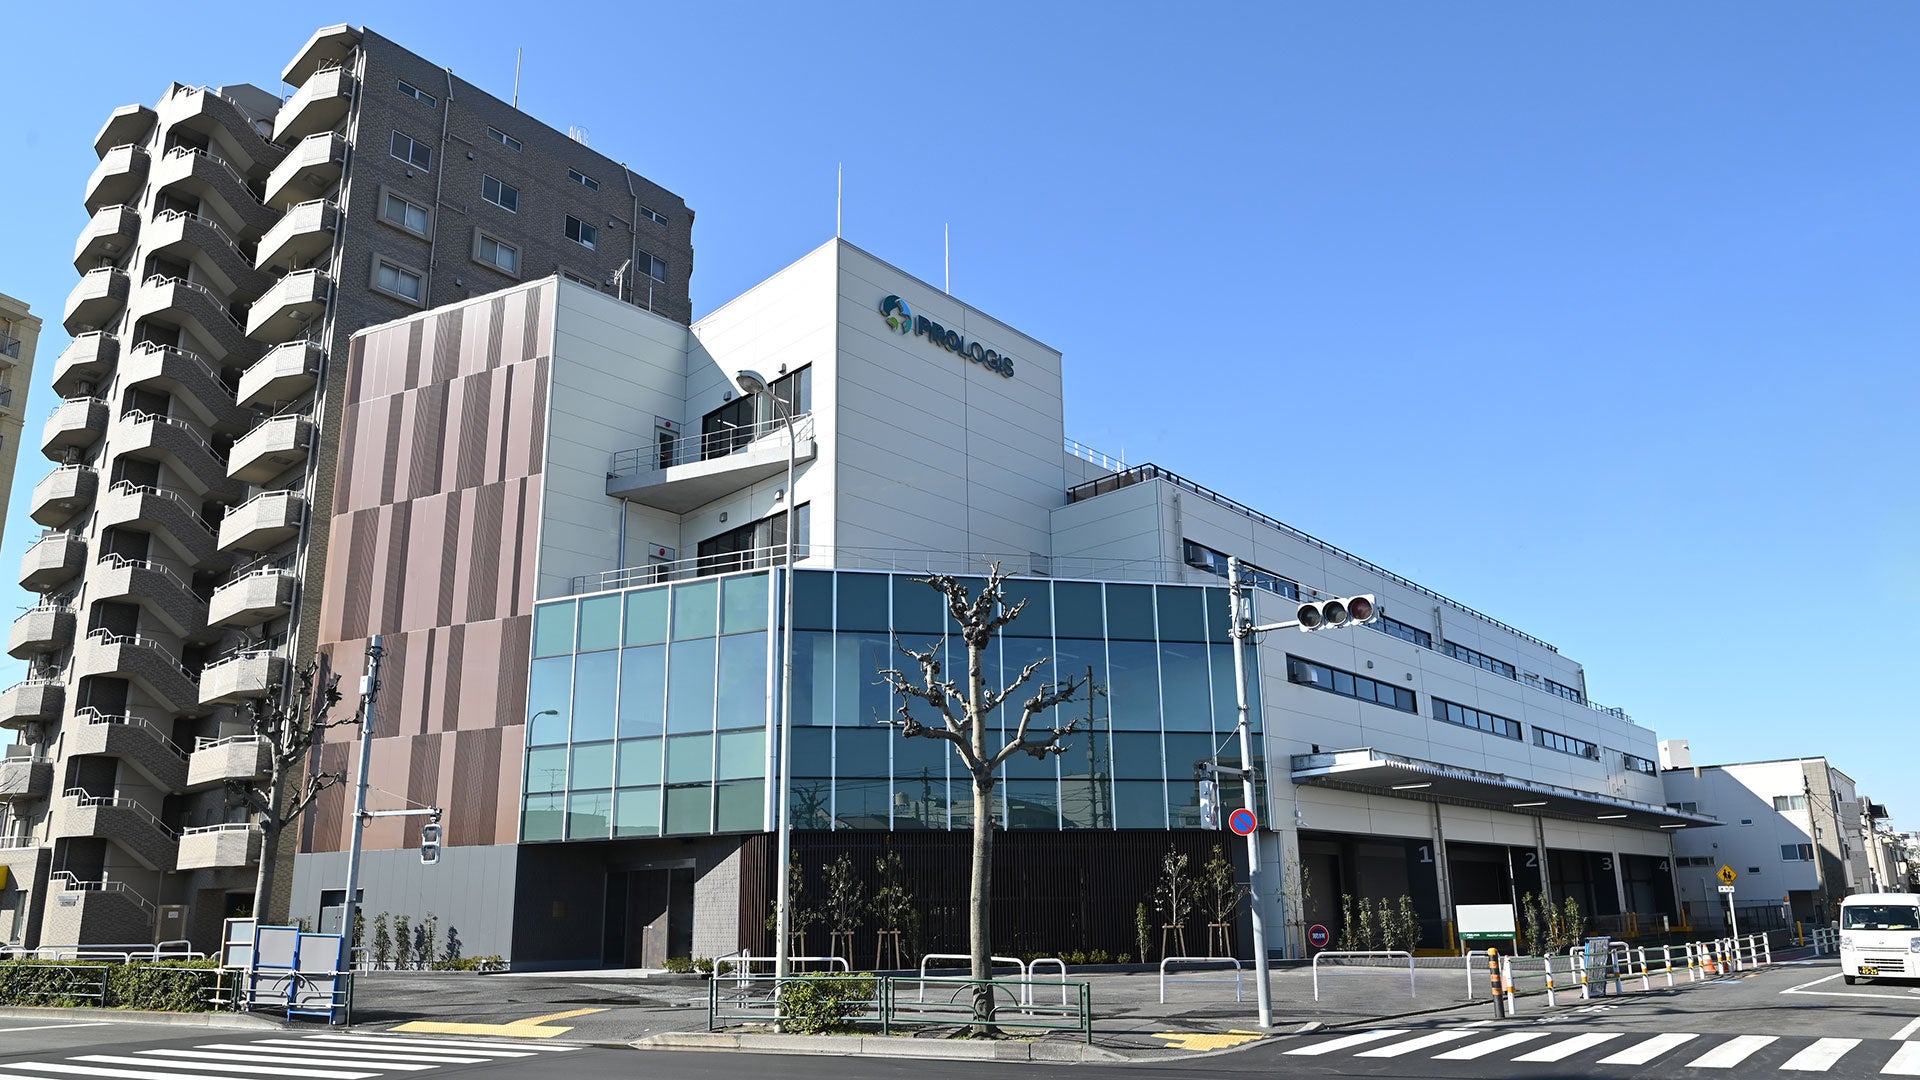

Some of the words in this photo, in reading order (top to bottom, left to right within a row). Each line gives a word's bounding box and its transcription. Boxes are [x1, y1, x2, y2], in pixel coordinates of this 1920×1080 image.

[916, 314, 1015, 378] PROLOGIS
[1418, 845, 1433, 863] 1
[1525, 852, 1537, 868] 2
[1601, 857, 1613, 871] 3
[1659, 860, 1670, 872] 4
